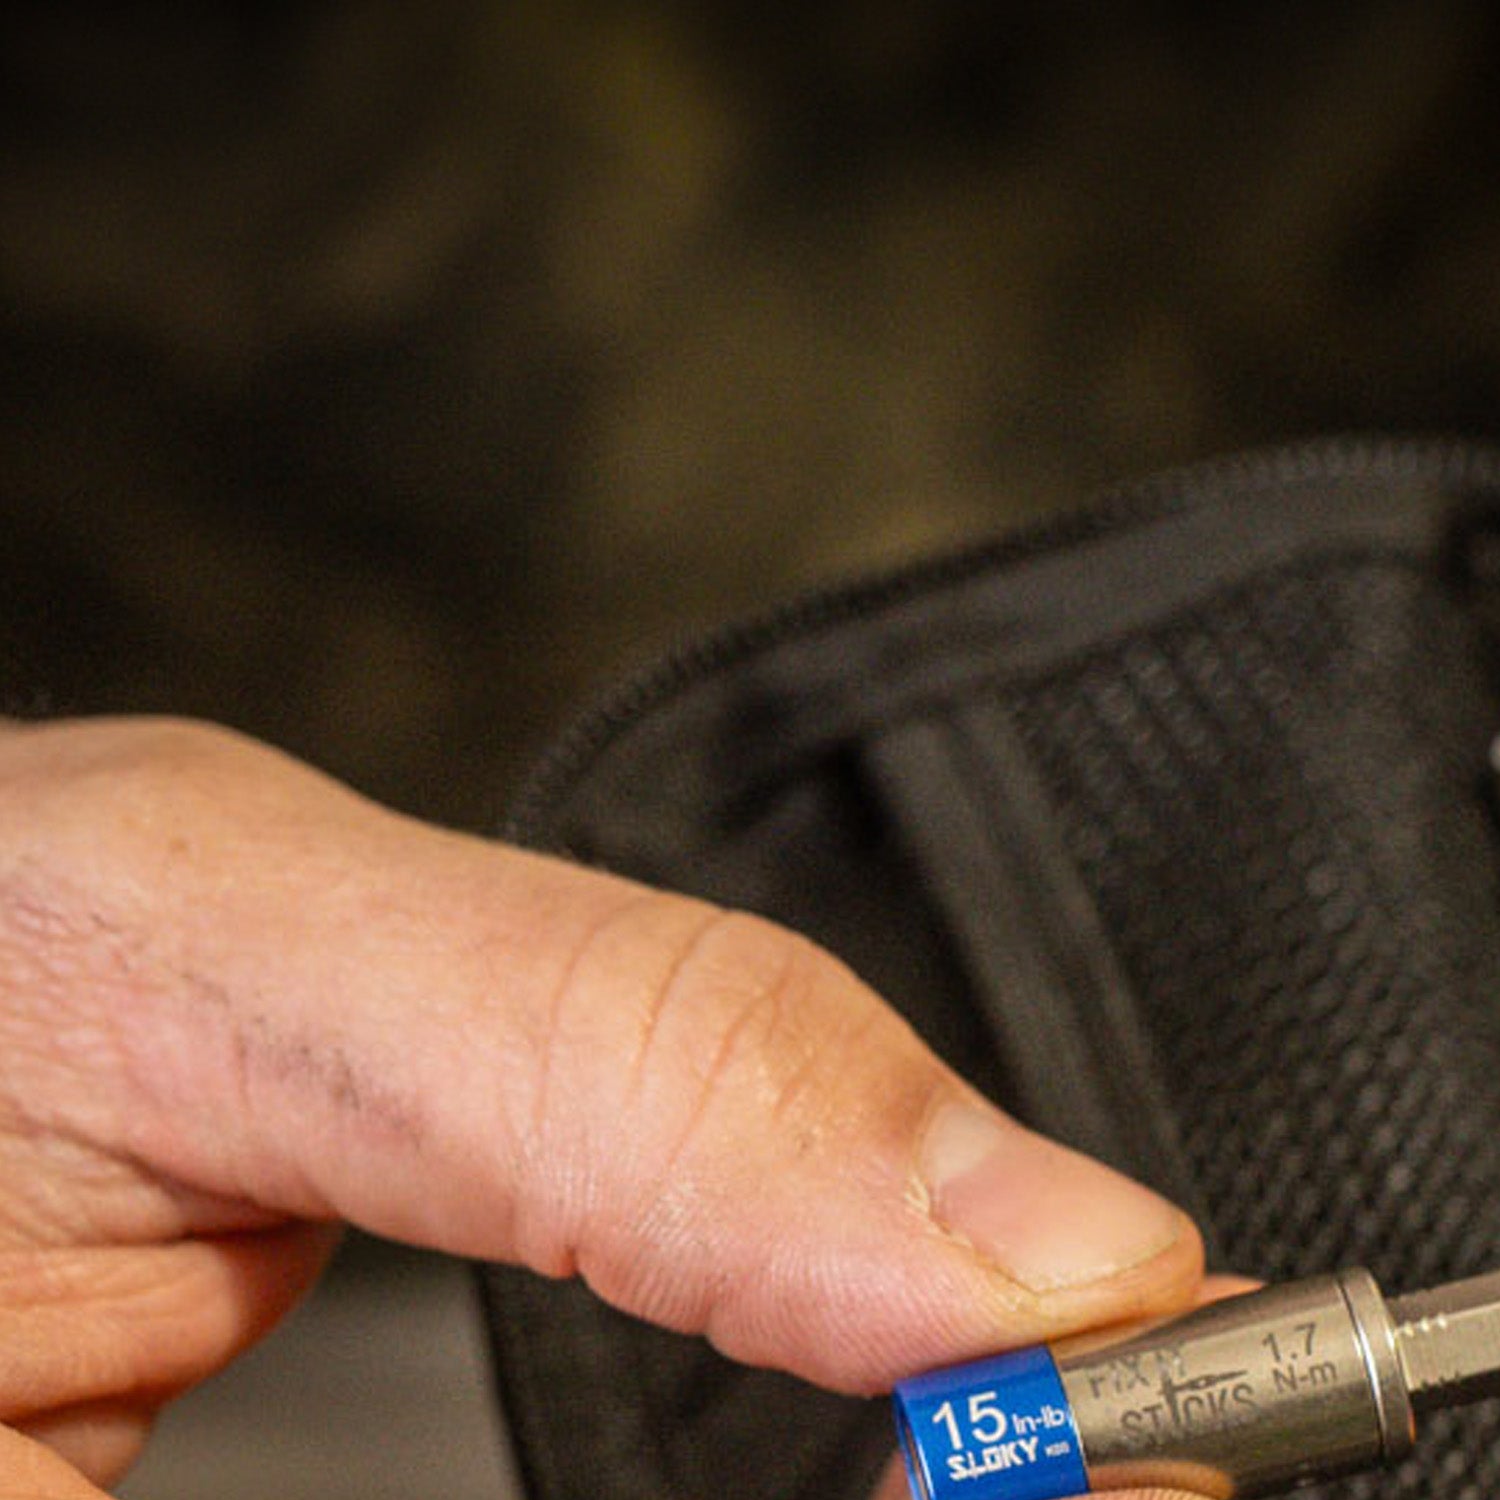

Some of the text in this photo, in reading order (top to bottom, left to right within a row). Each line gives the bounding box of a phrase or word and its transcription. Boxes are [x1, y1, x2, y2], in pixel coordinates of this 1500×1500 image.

[1261, 1321, 1317, 1363] 1.7
[1271, 1360, 1338, 1395] N-m
[932, 1391, 1008, 1450] 15
[946, 1436, 1039, 1482] SLOKY
